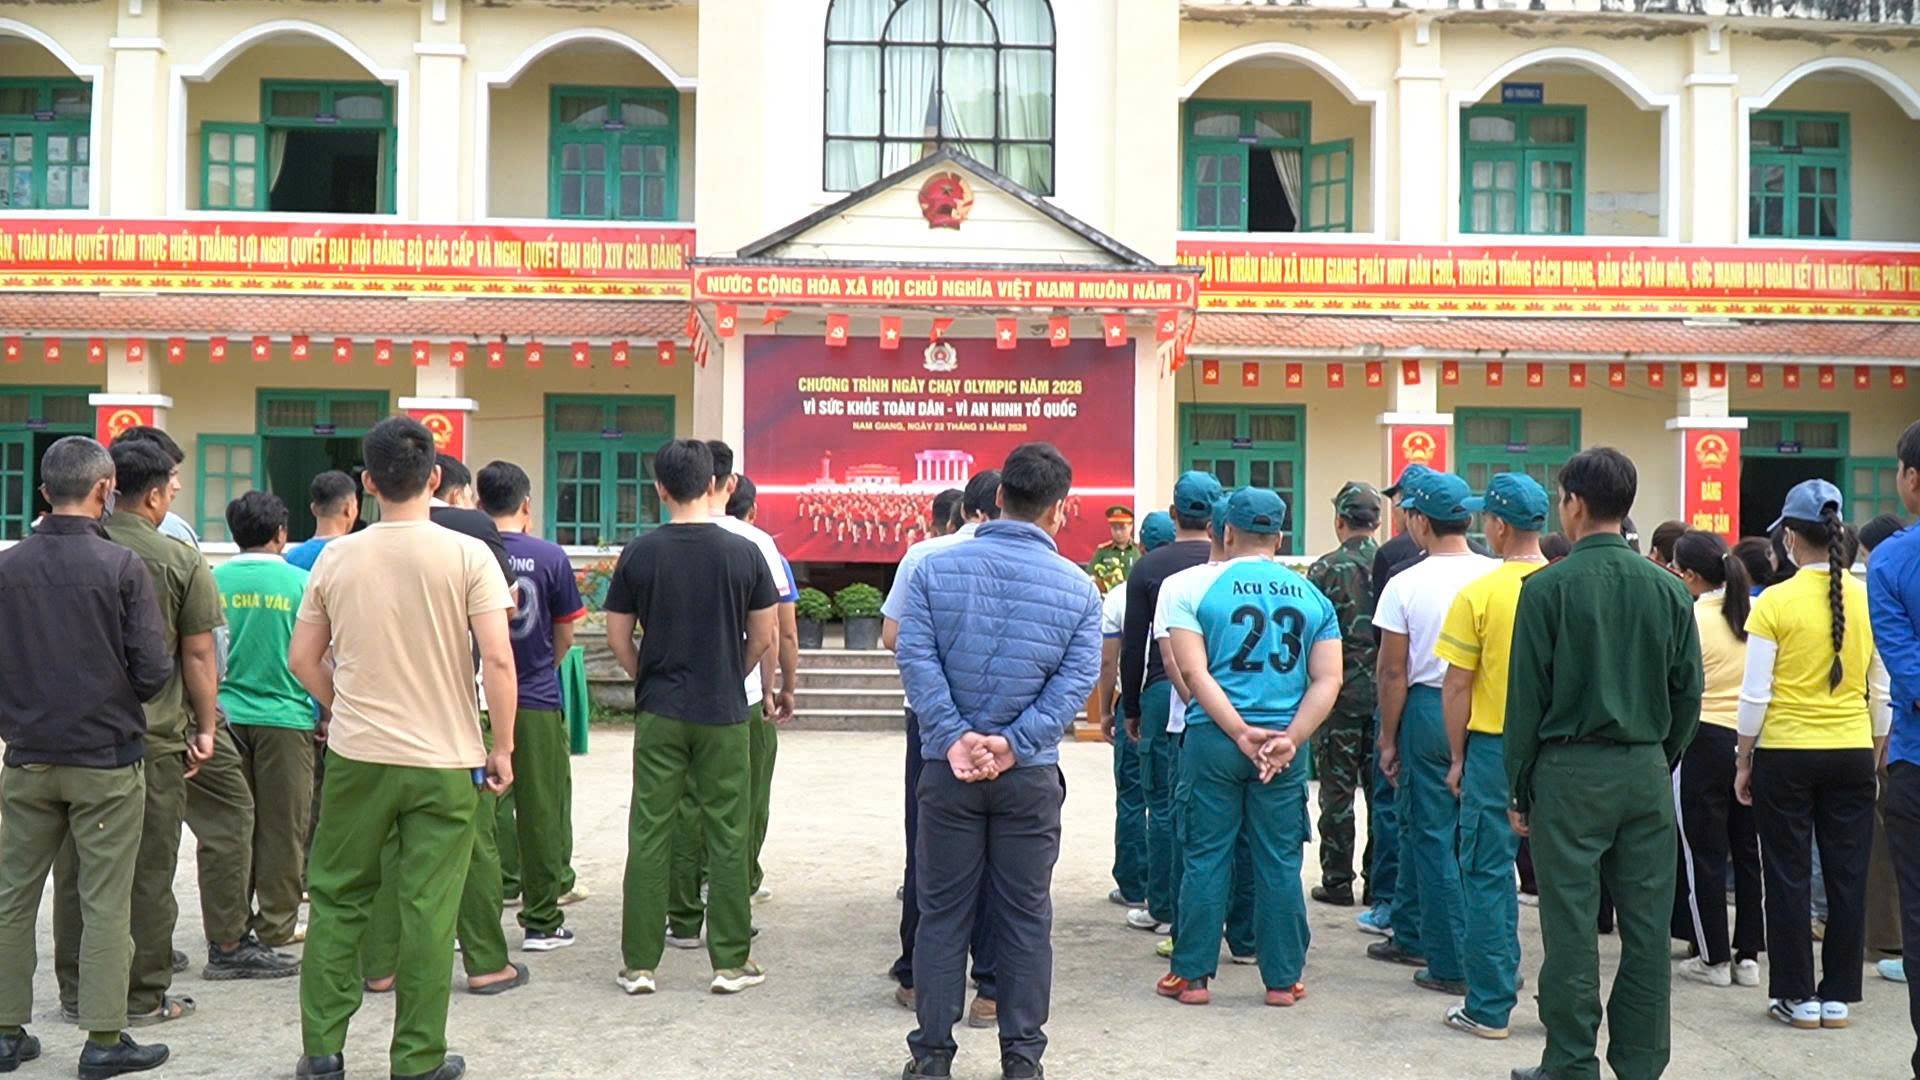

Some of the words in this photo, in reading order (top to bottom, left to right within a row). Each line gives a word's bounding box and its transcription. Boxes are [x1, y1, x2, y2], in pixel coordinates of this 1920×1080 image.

[18, 228, 47, 261] TOÀN
[51, 228, 73, 261] DÂN
[75, 225, 110, 264] QUYẾT
[112, 228, 136, 261] TÂM
[138, 231, 167, 267] THỰC
[170, 229, 197, 268] HIỆN
[200, 225, 238, 262] THẮNG
[260, 236, 288, 269] NGHỊ
[291, 229, 326, 266] QUYẾT
[328, 237, 349, 271] ĐẠI
[351, 232, 371, 271] HỘI
[373, 230, 405, 266] ĐẢNG
[407, 234, 423, 272] BỘ
[425, 234, 448, 266] CÁC
[451, 231, 475, 267] CẤP
[476, 235, 491, 267] VÀ
[493, 240, 522, 274] NGHỊ
[524, 233, 559, 270] QUYẾT
[561, 241, 580, 275] ĐẠI
[583, 237, 601, 275] HỘI
[605, 243, 623, 269] XIV
[626, 234, 649, 270] CỦA
[651, 234, 682, 270] ĐẢNG
[1214, 250, 1228, 282] VÀ
[707, 272, 752, 294] NƯỚC
[757, 273, 802, 298] CỘNG
[807, 275, 841, 295] HÒA
[845, 276, 869, 295] XÃ
[871, 276, 900, 299] HỘI
[904, 274, 937, 296] CHỦ
[942, 277, 993, 298] NGHĨA
[997, 278, 1032, 301] VIỆT
[1036, 281, 1075, 299] NAM
[1079, 279, 1129, 299] MUÔN
[1133, 279, 1172, 300] NĂM
[1176, 283, 1183, 300] !
[798, 377, 849, 392] CHƯƠNG
[852, 376, 889, 393] TRÌNH
[892, 376, 925, 393] NGÀY
[928, 379, 960, 396] CHẠY
[964, 379, 1017, 394] OLYMPIC
[1020, 378, 1049, 394] NĂM
[1052, 380, 1082, 395] 2026
[803, 398, 816, 415] VÌ
[819, 398, 844, 415] SỨC
[883, 398, 916, 416] TOÀN
[918, 399, 944, 416] DÂN
[955, 400, 968, 416] VÌ
[970, 402, 988, 416] AN
[992, 402, 1022, 417] NINH
[1025, 397, 1041, 417] TỔ
[1043, 398, 1077, 419] QUỐC
[853, 422, 873, 430] NAM
[875, 422, 906, 431] GIANG,
[907, 421, 933, 431] NGÀY
[947, 422, 977, 431] THÁNG
[986, 422, 1006, 431] NĂM
[1233, 581, 1262, 595] Acu
[1231, 604, 1306, 674] 23
